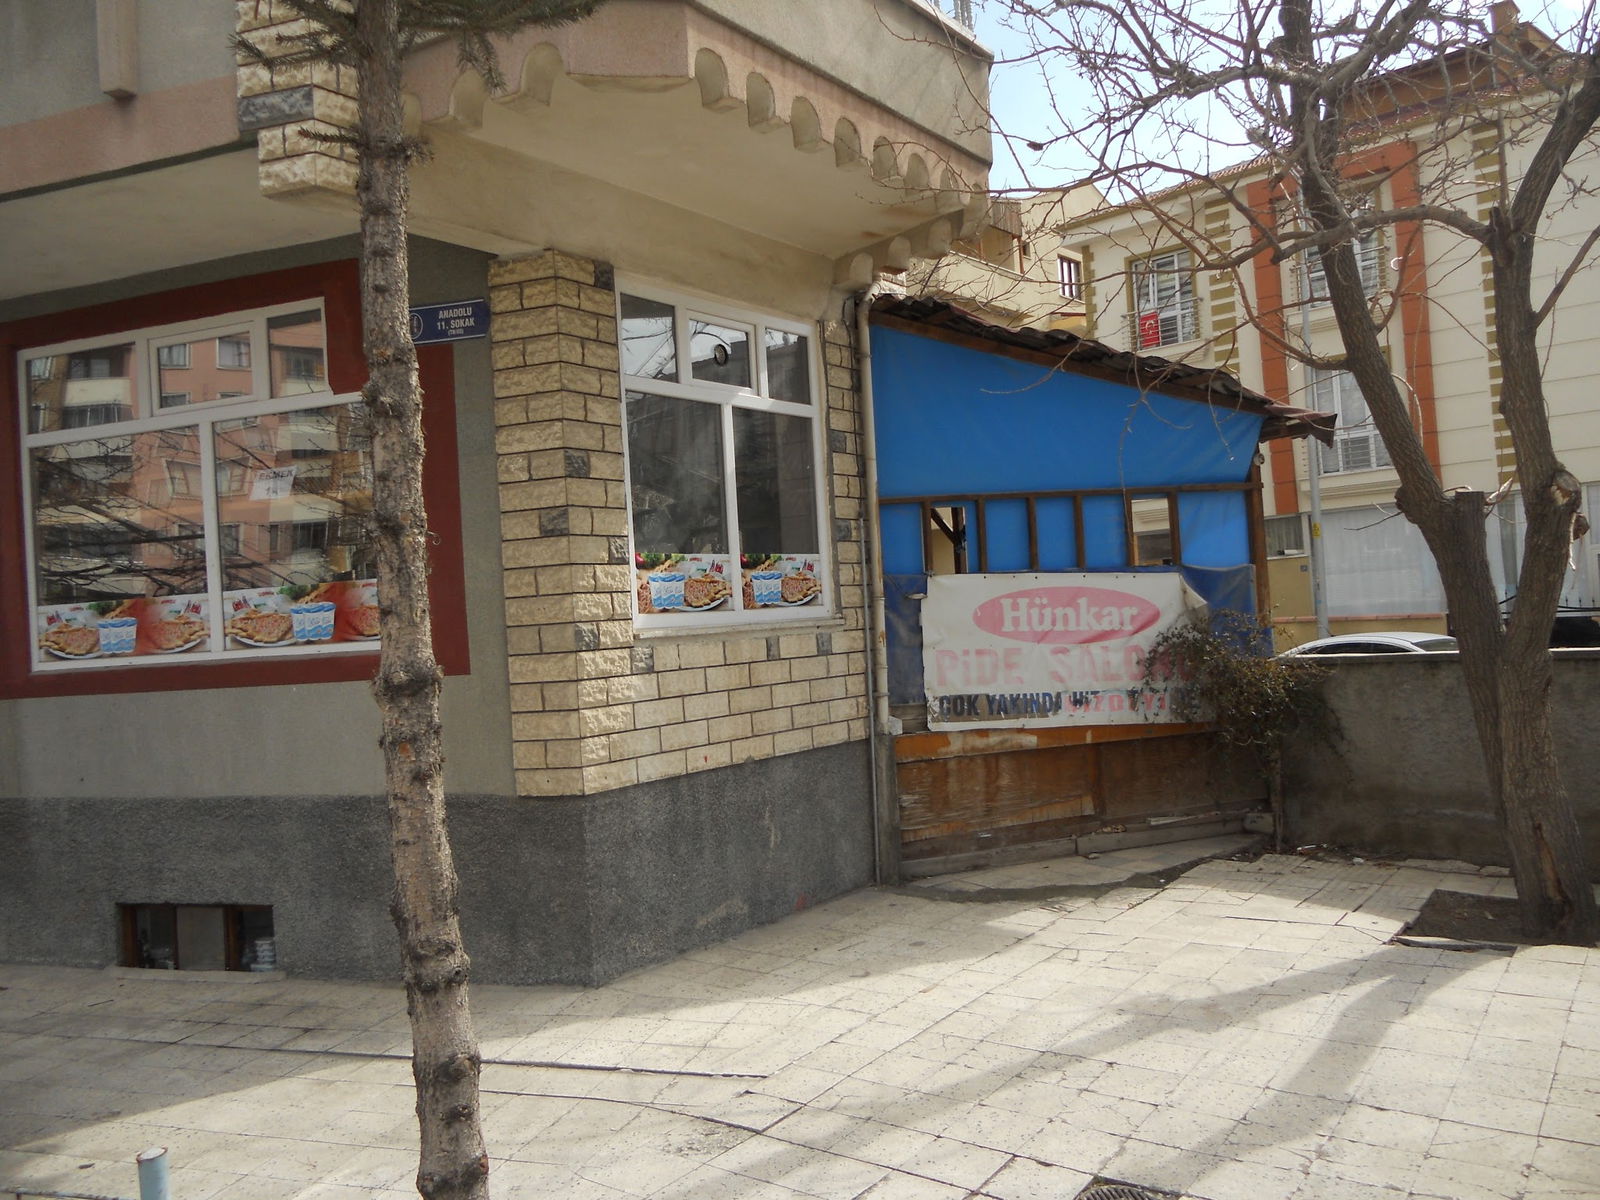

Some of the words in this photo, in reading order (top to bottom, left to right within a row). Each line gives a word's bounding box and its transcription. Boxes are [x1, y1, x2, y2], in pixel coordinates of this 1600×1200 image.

[439, 307, 472, 319] ANADOLU
[437, 321, 449, 330] 11.
[450, 317, 475, 329] SOKAK
[1000, 597, 1138, 632] Hünkar
